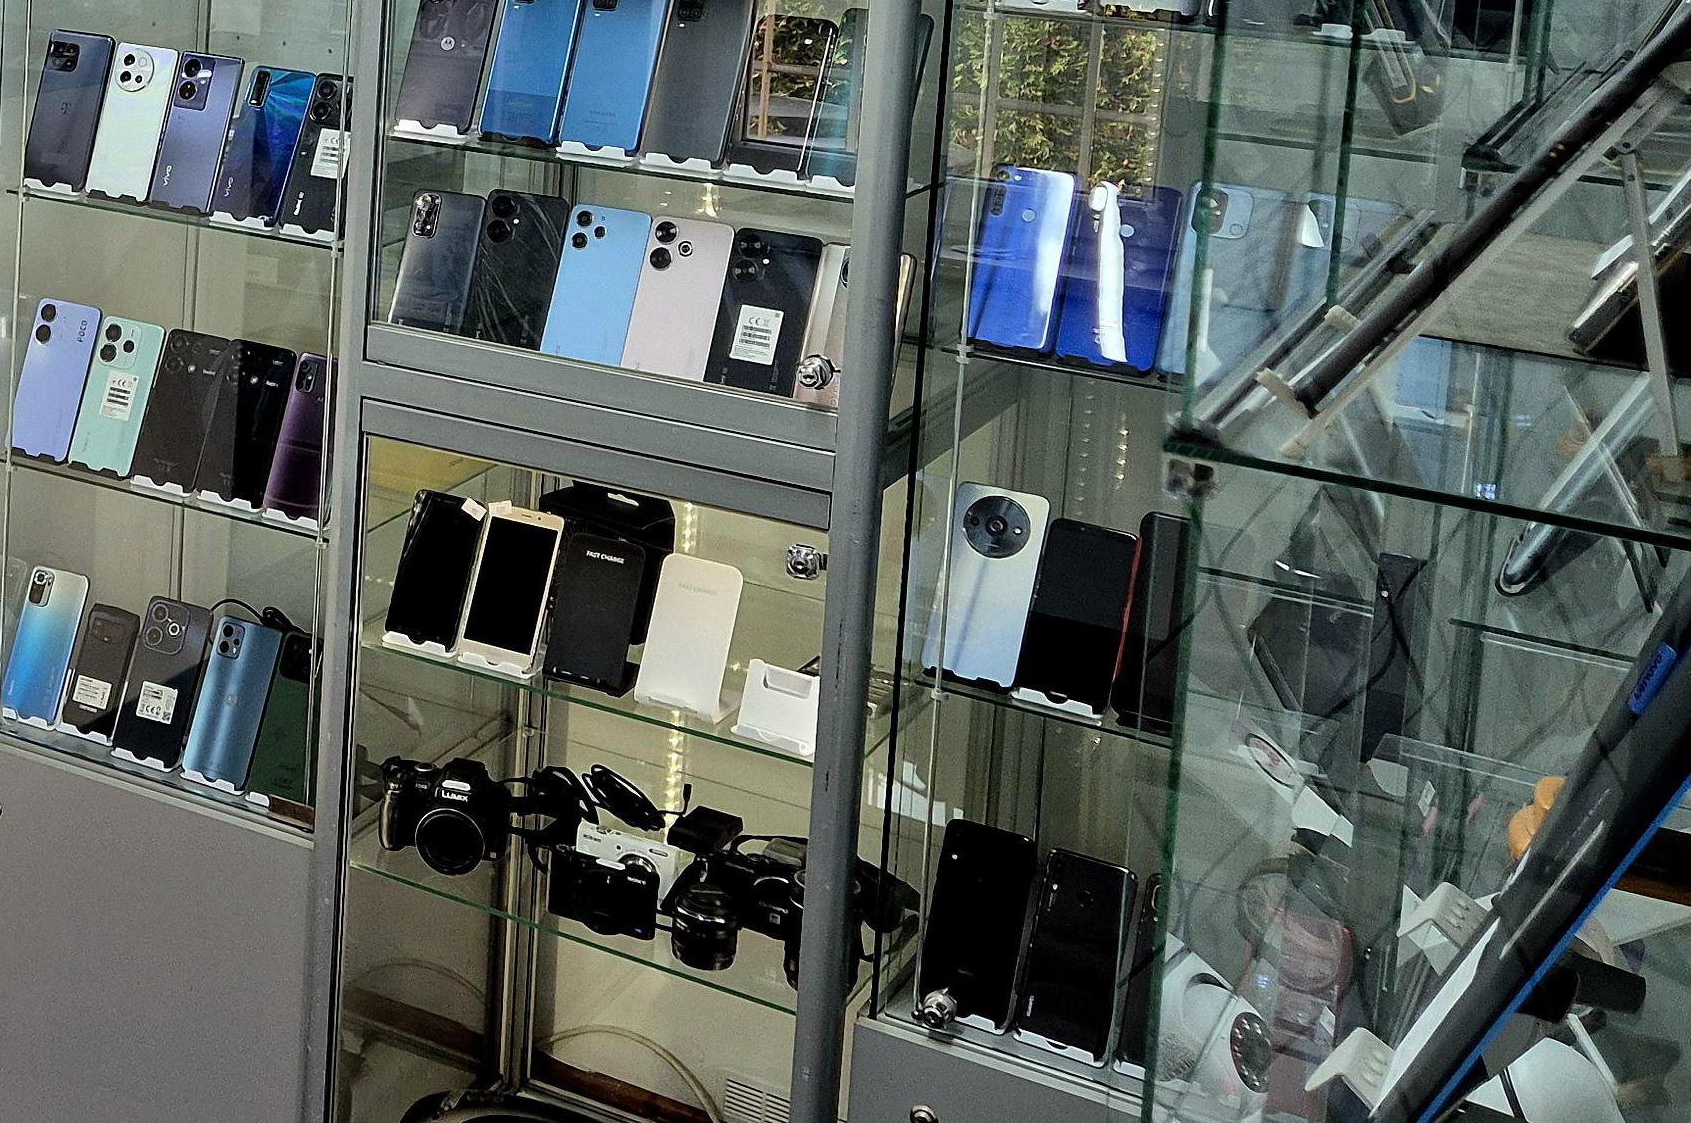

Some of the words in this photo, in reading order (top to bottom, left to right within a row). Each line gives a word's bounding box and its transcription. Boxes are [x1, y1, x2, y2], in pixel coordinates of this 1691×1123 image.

[77, 320, 88, 343] POCO
[586, 550, 601, 560] FAST
[601, 554, 625, 564] CHARGE
[442, 790, 469, 802] LUMIX
